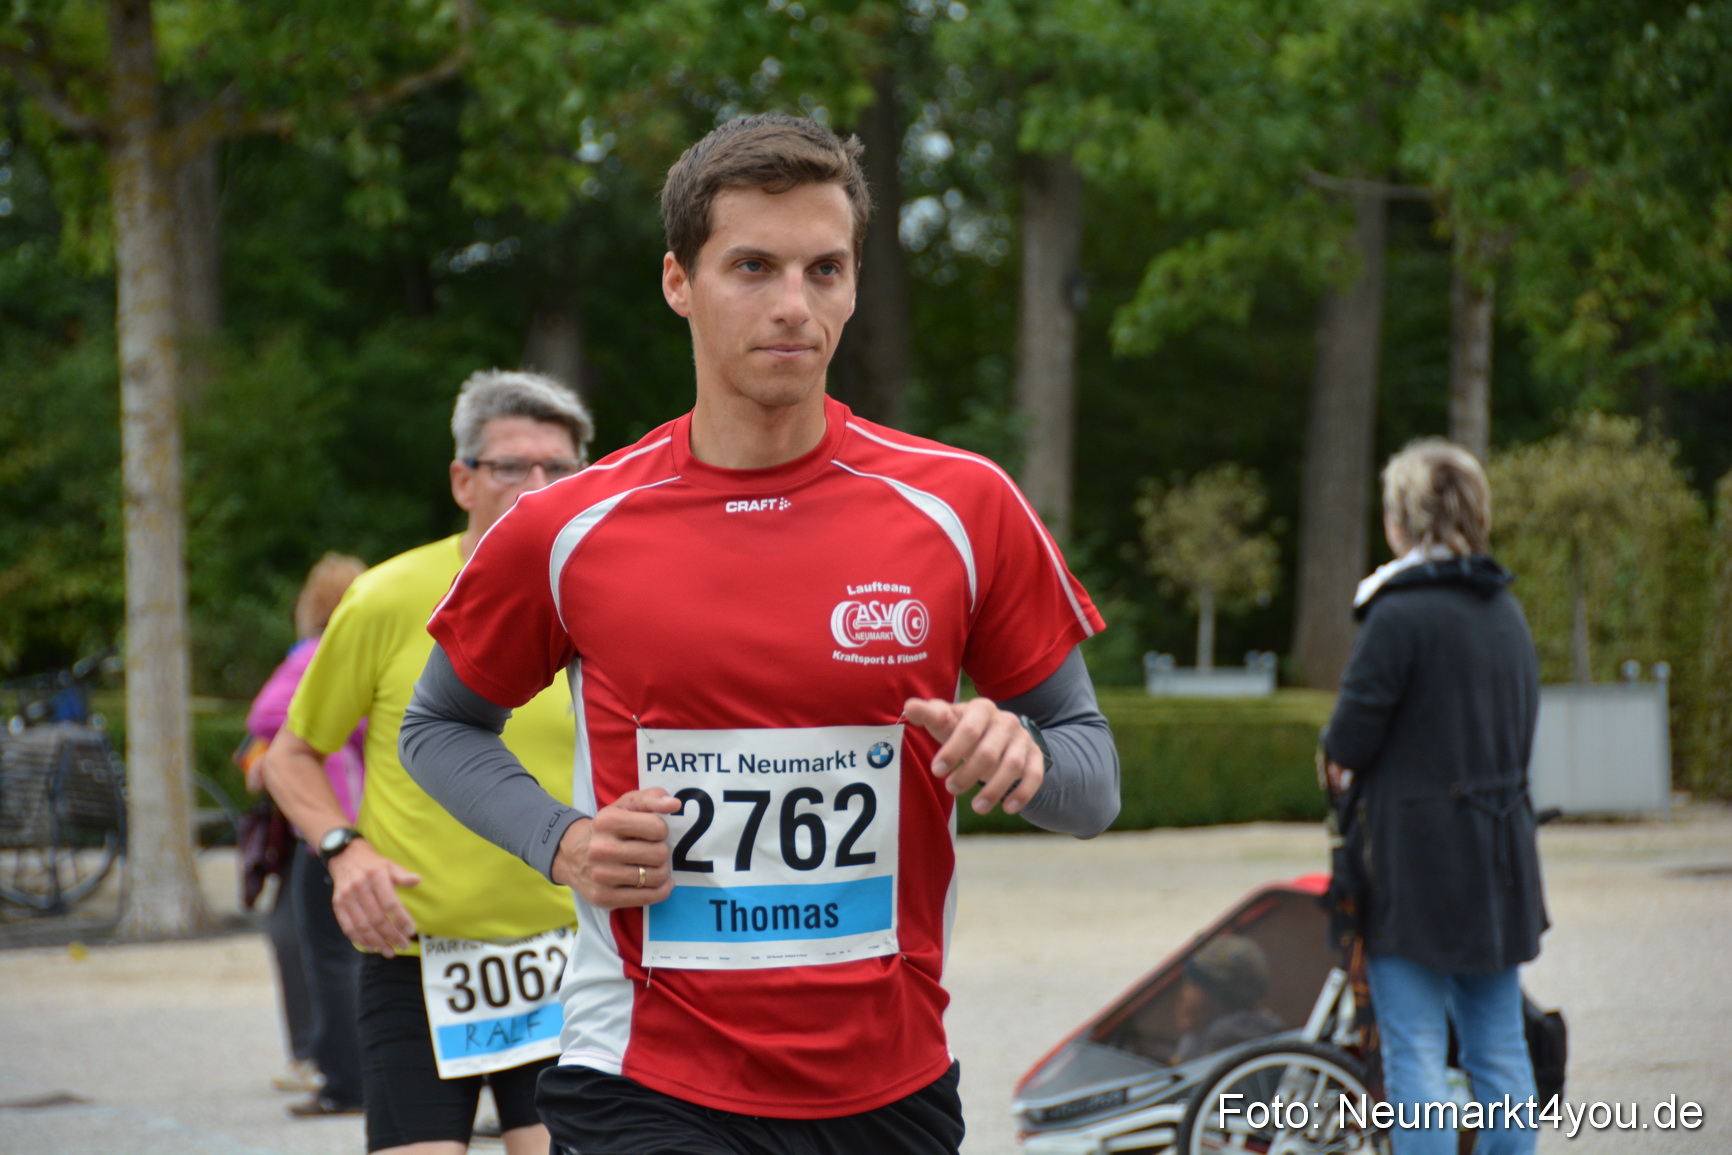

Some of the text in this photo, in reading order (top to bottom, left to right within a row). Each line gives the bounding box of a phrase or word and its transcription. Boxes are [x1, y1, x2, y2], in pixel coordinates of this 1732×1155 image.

[725, 498, 777, 513] CRAFT
[846, 581, 911, 596] Laufteam
[856, 600, 894, 629] ASV
[855, 632, 894, 641] NEUMARKT
[832, 649, 928, 666] Kraftsport & Fitness
[646, 750, 857, 774] PARTL Neumarkt
[669, 782, 878, 873] 2762
[709, 899, 839, 932] Thomas
[444, 945, 568, 1014] 3062
[465, 1010, 542, 1052] RALF
